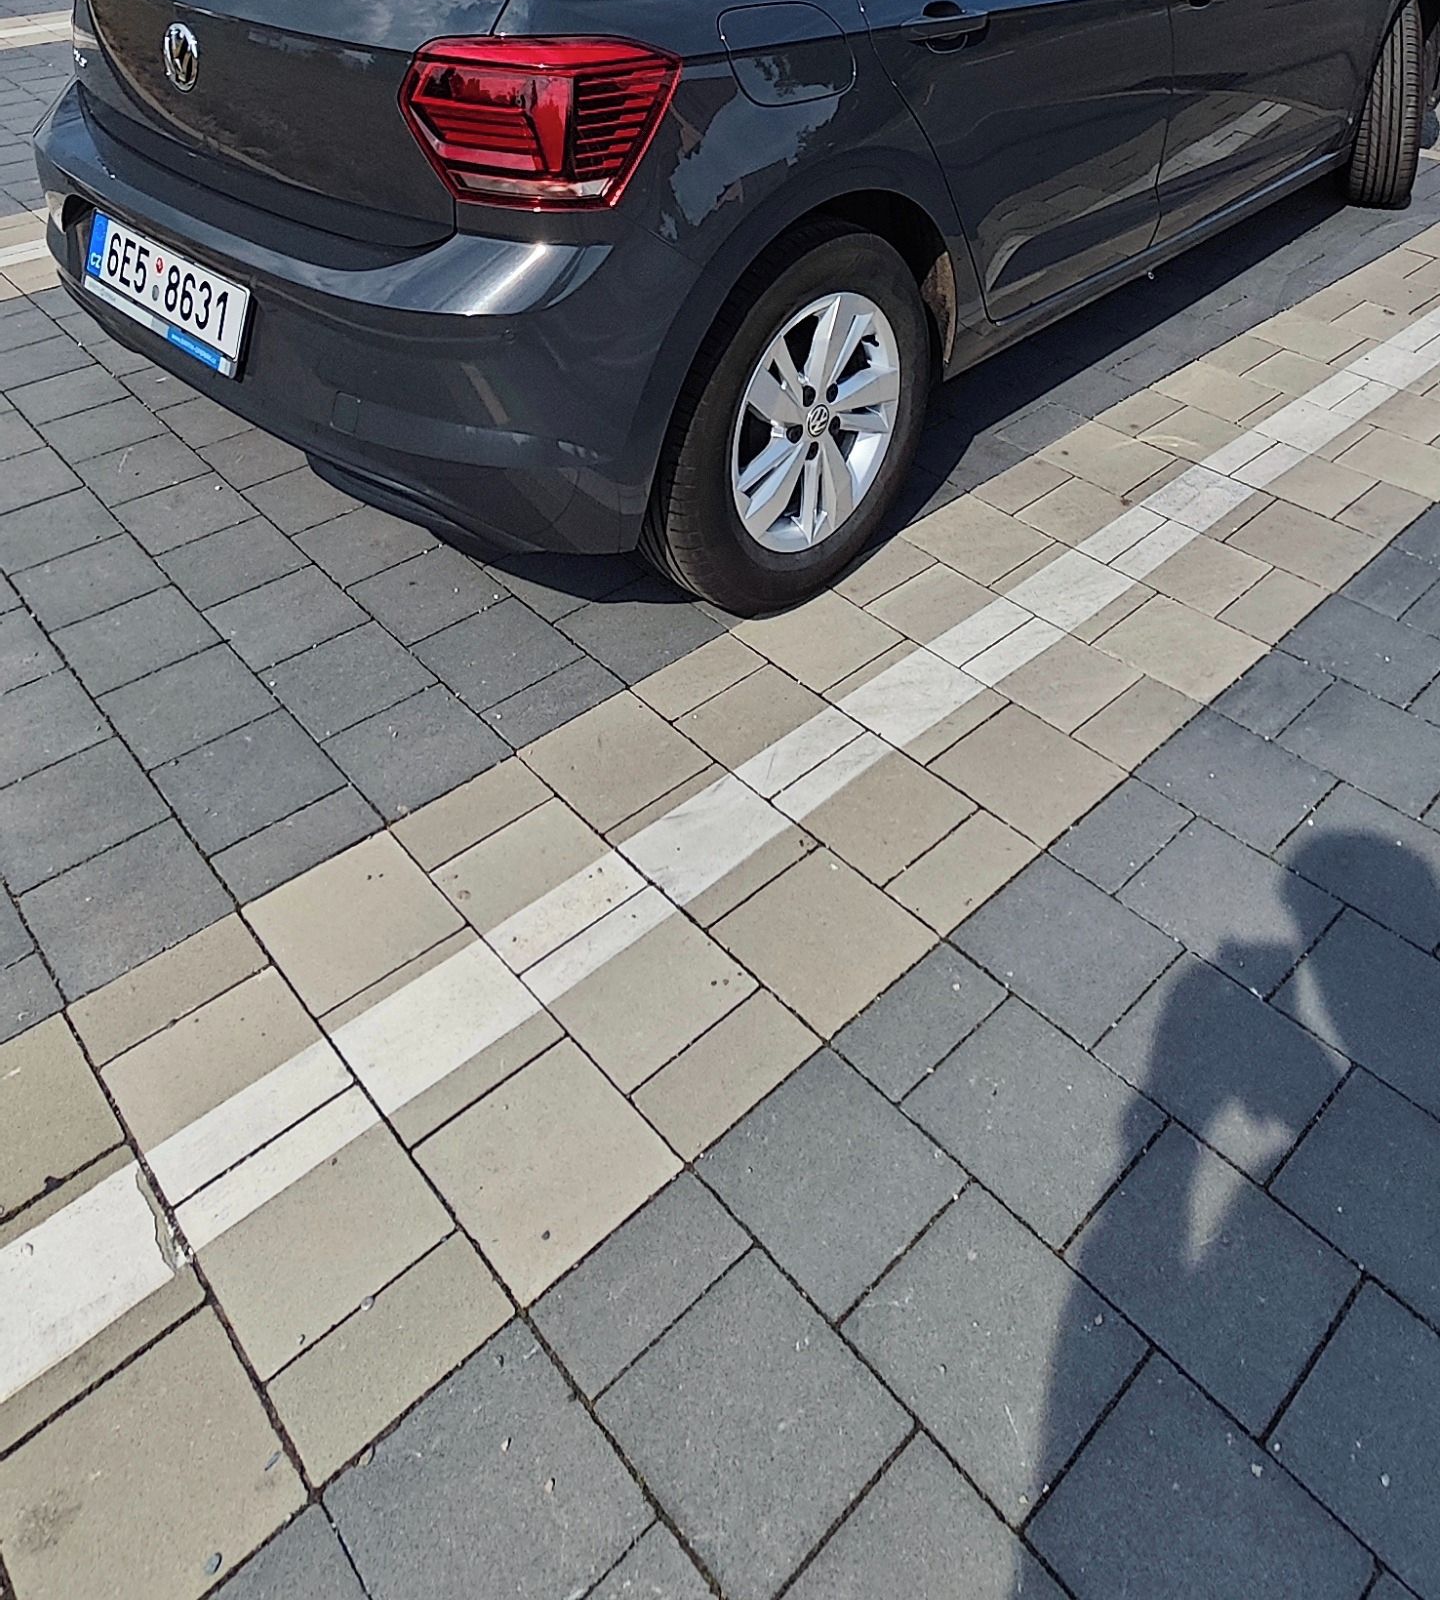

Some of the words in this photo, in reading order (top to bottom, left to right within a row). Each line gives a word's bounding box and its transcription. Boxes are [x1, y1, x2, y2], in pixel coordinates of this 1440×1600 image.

[90, 252, 102, 269] CZ
[107, 232, 150, 294] 6E5
[164, 264, 229, 341] 8631
